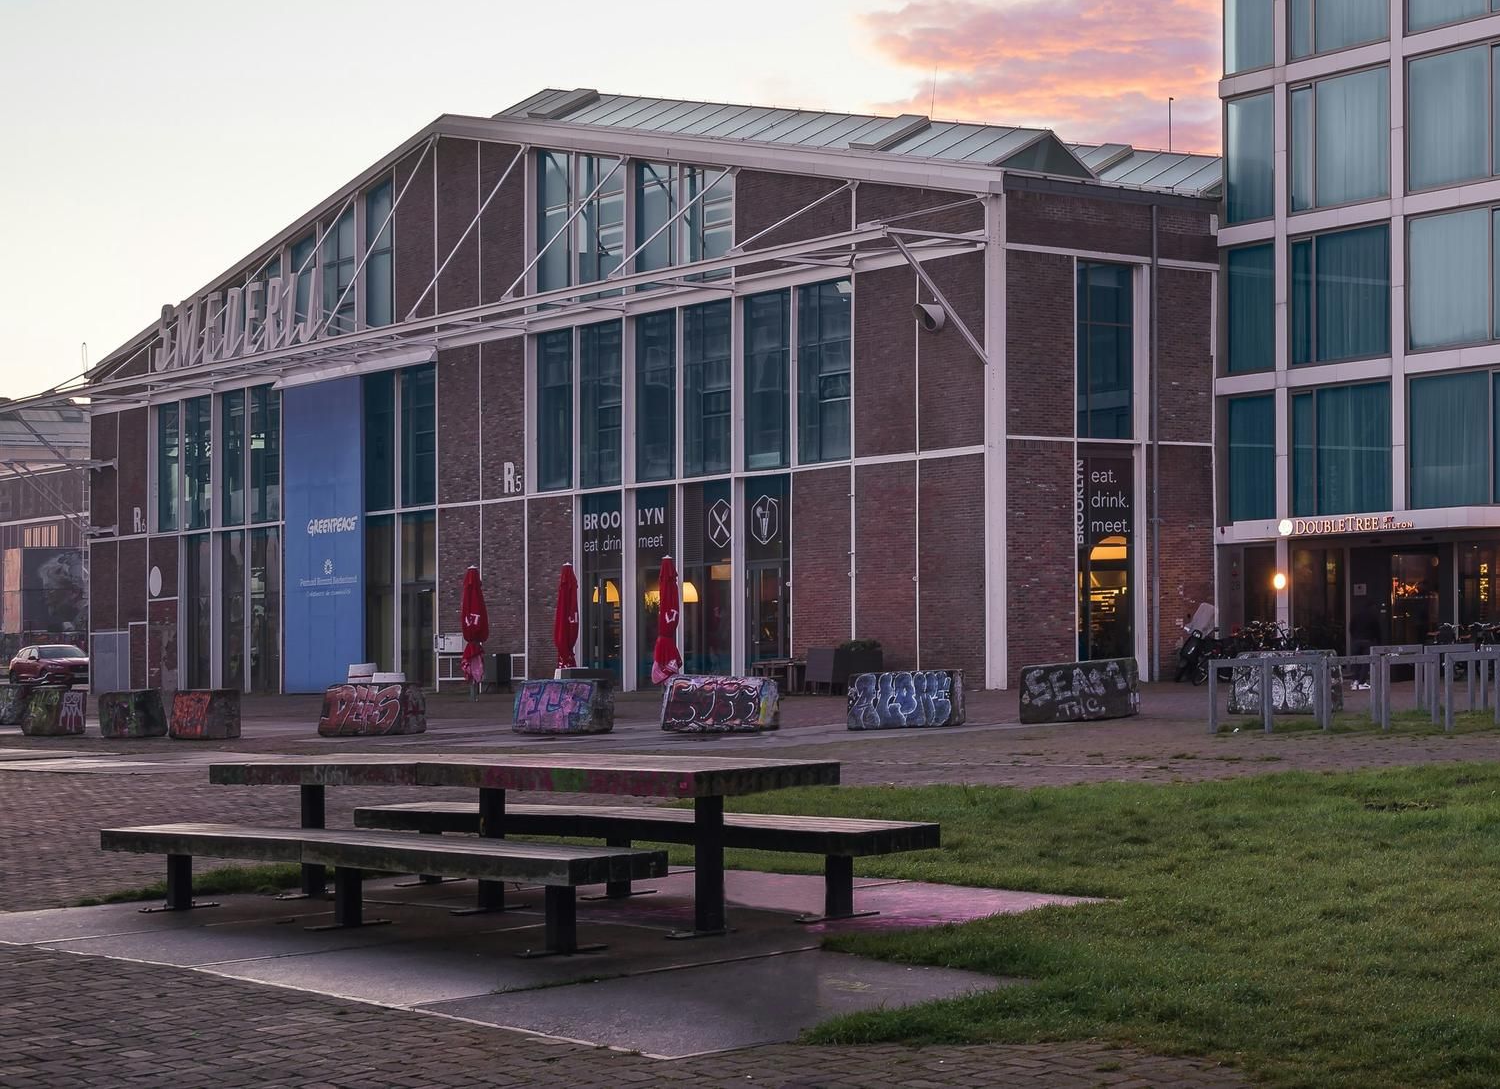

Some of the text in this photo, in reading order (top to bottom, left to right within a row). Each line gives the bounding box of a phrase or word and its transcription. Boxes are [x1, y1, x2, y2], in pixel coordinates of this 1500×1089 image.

[155, 267, 321, 372] SMEDERIJ
[1091, 469, 1117, 483] eat.
[1091, 490, 1130, 508] drink.
[306, 515, 359, 537] GREENPEACE
[584, 507, 665, 531] BROOLYN
[1091, 519, 1131, 533] meet.
[1382, 520, 1414, 530] HILTON
